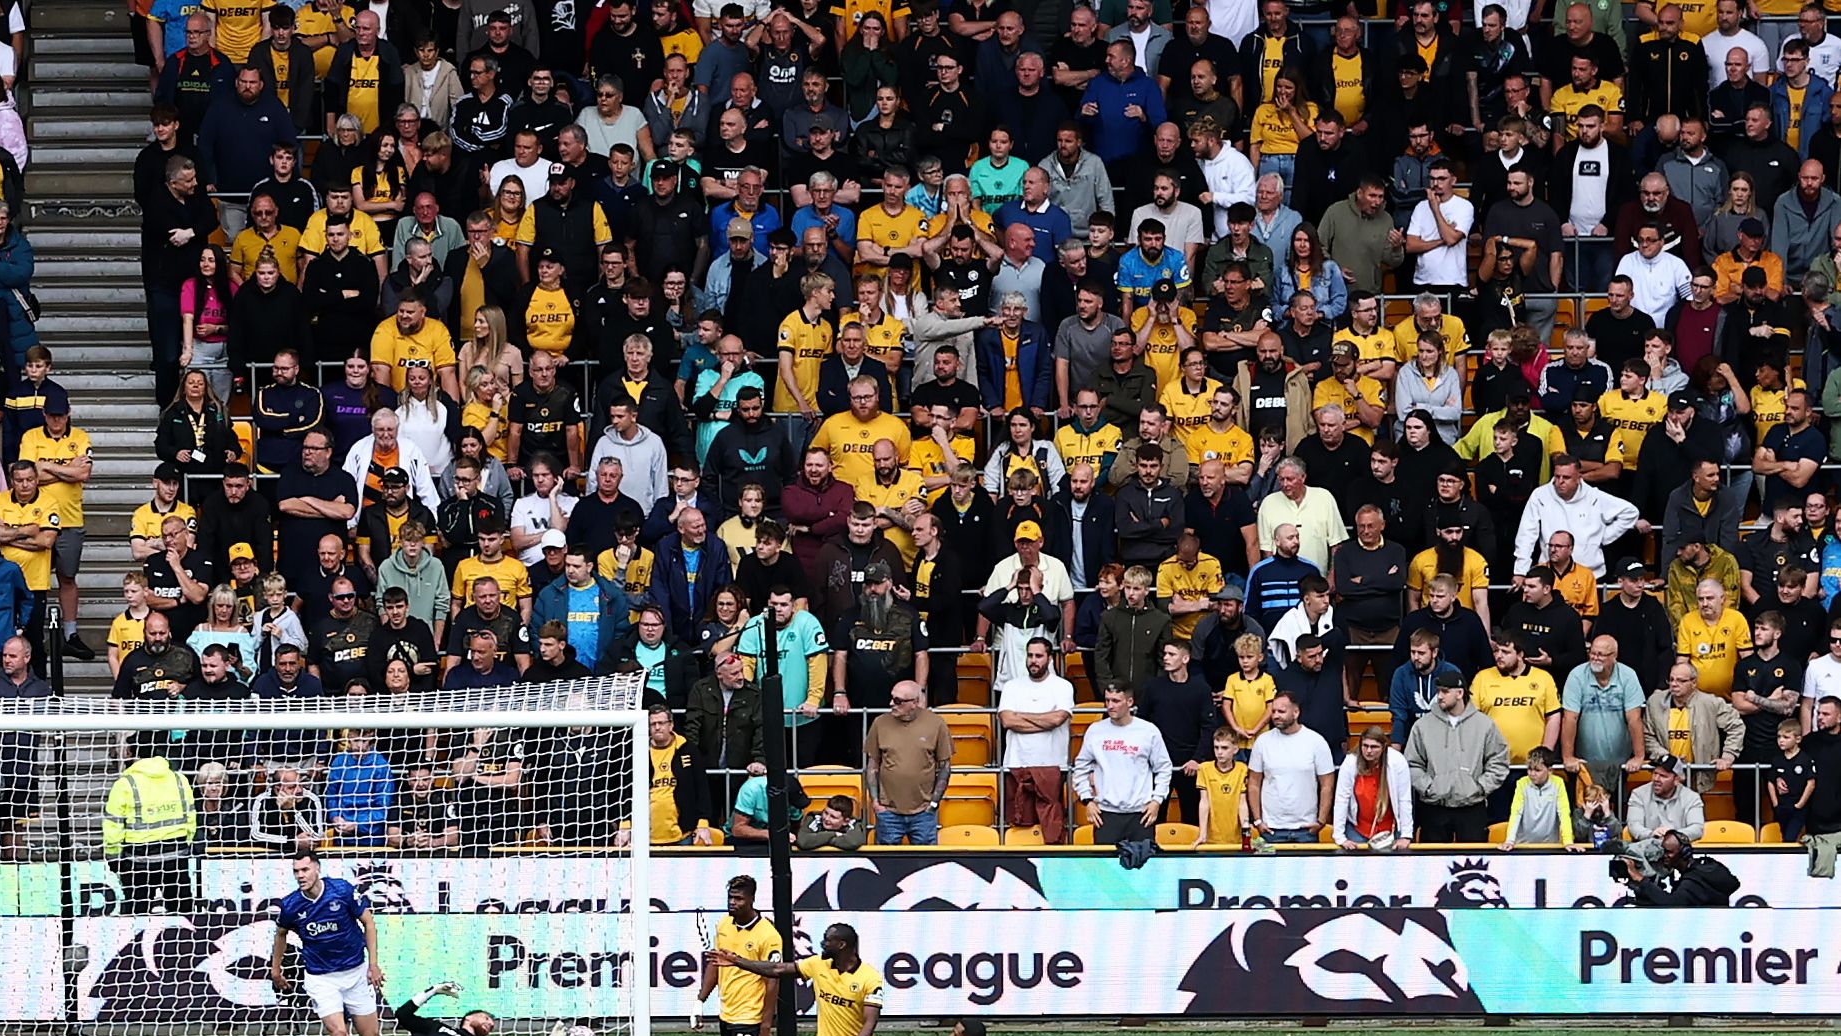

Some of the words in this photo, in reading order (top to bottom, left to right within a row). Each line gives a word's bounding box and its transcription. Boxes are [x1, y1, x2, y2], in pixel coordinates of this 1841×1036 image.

[219, 6, 258, 17] DEBET
[1682, 4, 1705, 13] BET
[1267, 123, 1296, 133] AstroP
[530, 312, 570, 324] DEBET
[1255, 396, 1287, 409] DEBE
[527, 421, 563, 433] DEBET
[843, 443, 874, 453] DEBE
[154, 586, 182, 599] DEBE
[567, 611, 601, 623] EBET
[856, 638, 897, 651] DEBET
[334, 647, 369, 662] DEBE
[1493, 696, 1537, 707] DEBET
[1668, 730, 1690, 741] EBE
[305, 920, 339, 938] Stake
[1579, 930, 1819, 985] Premier
[884, 951, 1085, 1006] eague
[818, 989, 856, 1009] DEBET
